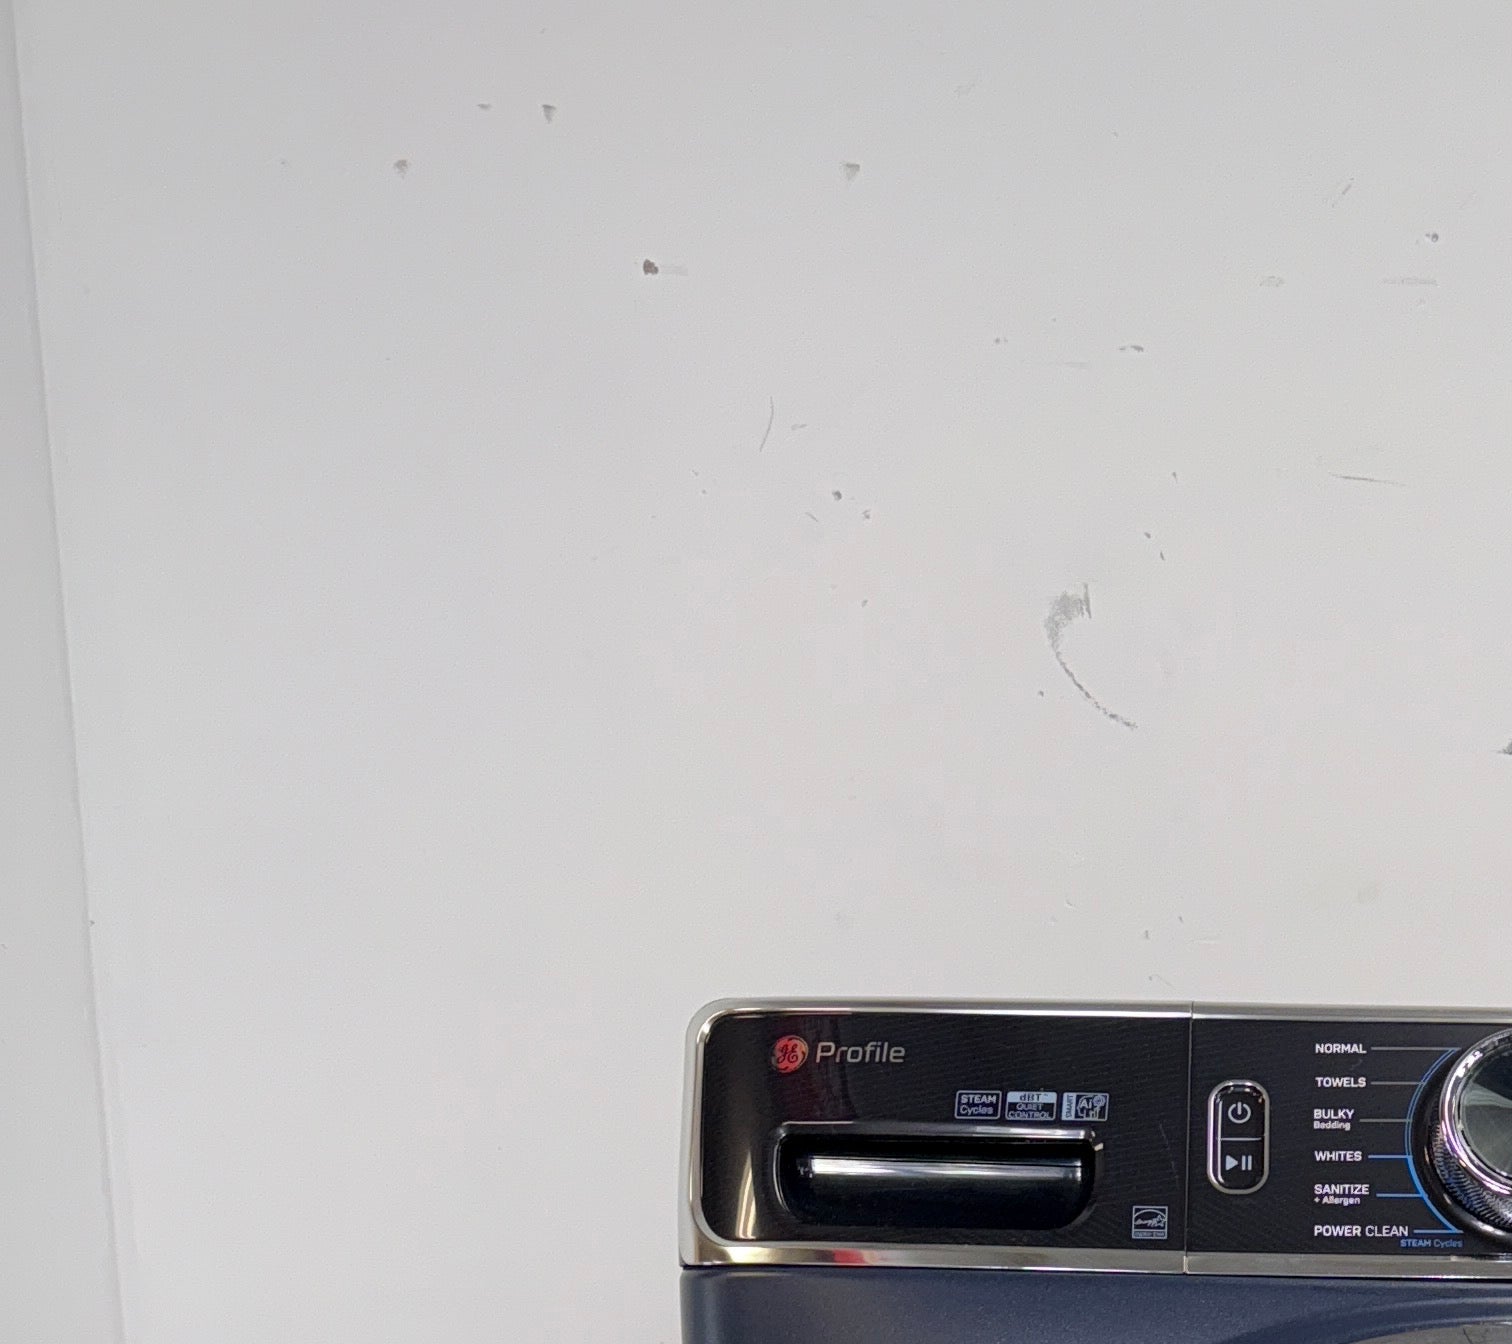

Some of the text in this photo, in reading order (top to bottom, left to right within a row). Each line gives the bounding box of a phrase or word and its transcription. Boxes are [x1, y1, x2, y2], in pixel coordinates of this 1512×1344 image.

[816, 1041, 905, 1063] Profile
[1315, 1043, 1367, 1054] NORMAL
[1315, 1077, 1367, 1088] TOWELS
[960, 1094, 996, 1104] STEAM
[959, 1105, 994, 1115] Cycles
[1009, 1110, 1050, 1119] CONTROL
[1313, 1108, 1355, 1119] BULKY
[1313, 1120, 1351, 1131] Bedding
[1314, 1150, 1363, 1162] WHITES
[1314, 1184, 1370, 1195] SANITIZE
[1322, 1195, 1361, 1207] Allergen
[1314, 1224, 1409, 1237] POWER CLEAN
[1400, 1238, 1464, 1249] STEAM Cycles
